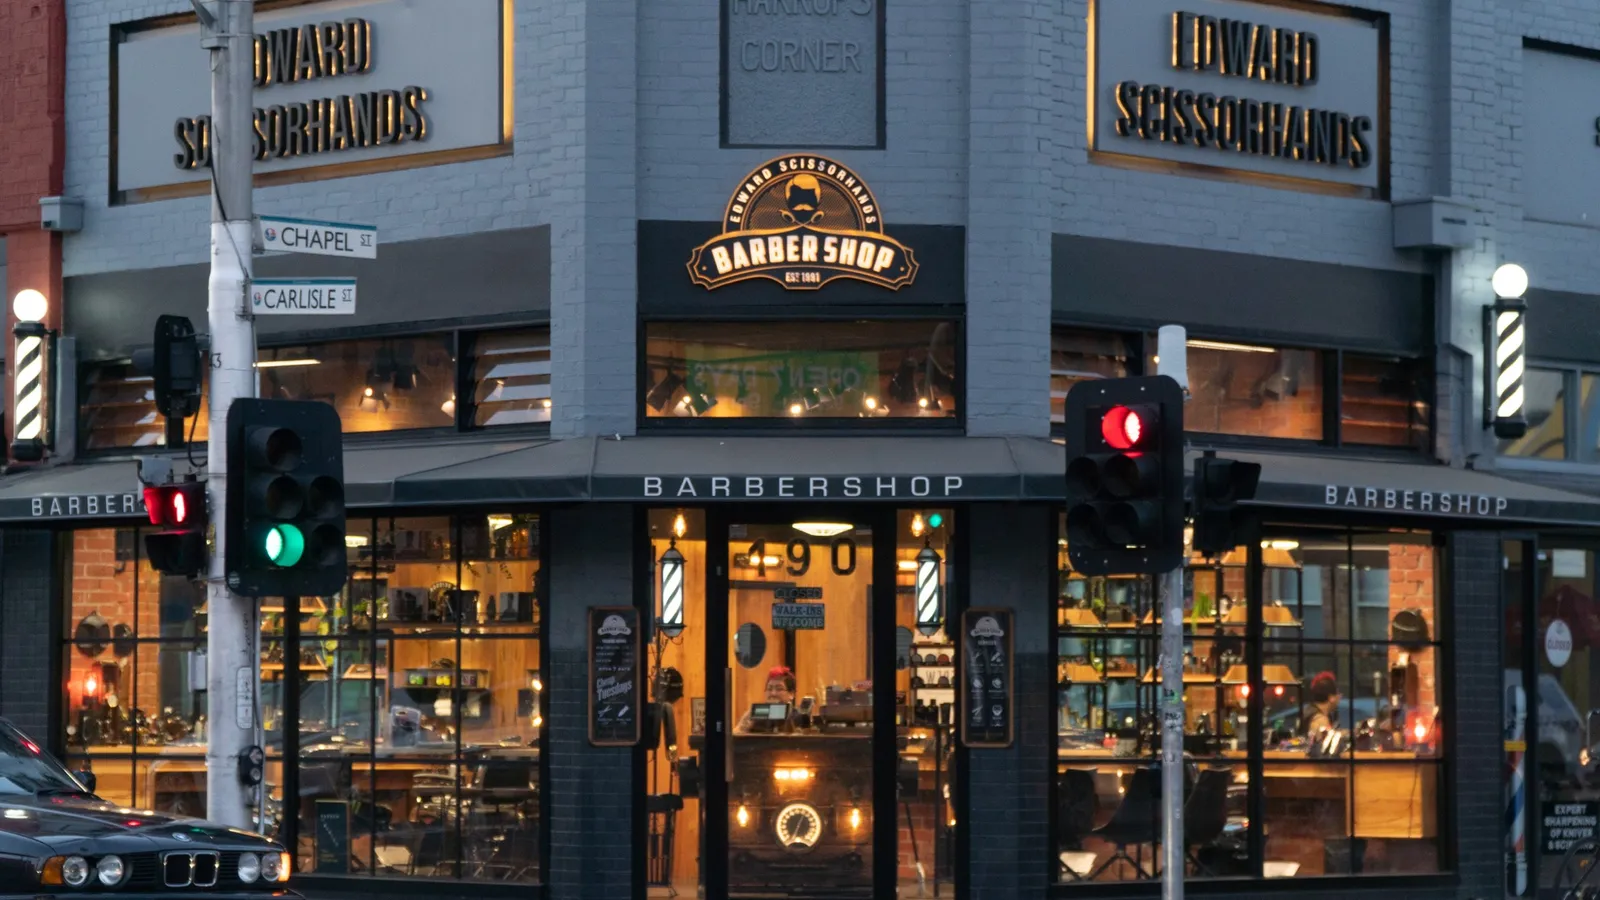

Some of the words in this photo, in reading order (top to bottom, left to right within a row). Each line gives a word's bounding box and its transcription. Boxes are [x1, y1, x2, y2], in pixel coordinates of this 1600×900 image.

[253, 17, 371, 88] DWARD
[741, 40, 861, 73] CORNER
[1171, 10, 1320, 87] EDWARD
[173, 85, 427, 170] SCSORHANDS
[1115, 80, 1372, 169] SCISSORHANDS
[730, 168, 772, 223] EDWARD
[779, 158, 877, 224] SCISSORHANDS
[281, 226, 354, 252] CHAPEL
[360, 234, 372, 247] ST
[264, 289, 336, 309] CARLISLE
[342, 289, 352, 302] ST
[643, 476, 963, 497] BARBERSHOP
[31, 494, 149, 517] BARBER
[1325, 485, 1508, 516] BARBERSHOP
[775, 587, 821, 598] CLOSED
[775, 605, 822, 616] WALK-INS
[773, 617, 823, 628] WELCOME
[1554, 804, 1587, 815] EXPERT
[1544, 816, 1597, 827] SHARPENING
[1550, 829, 1561, 838] OF
